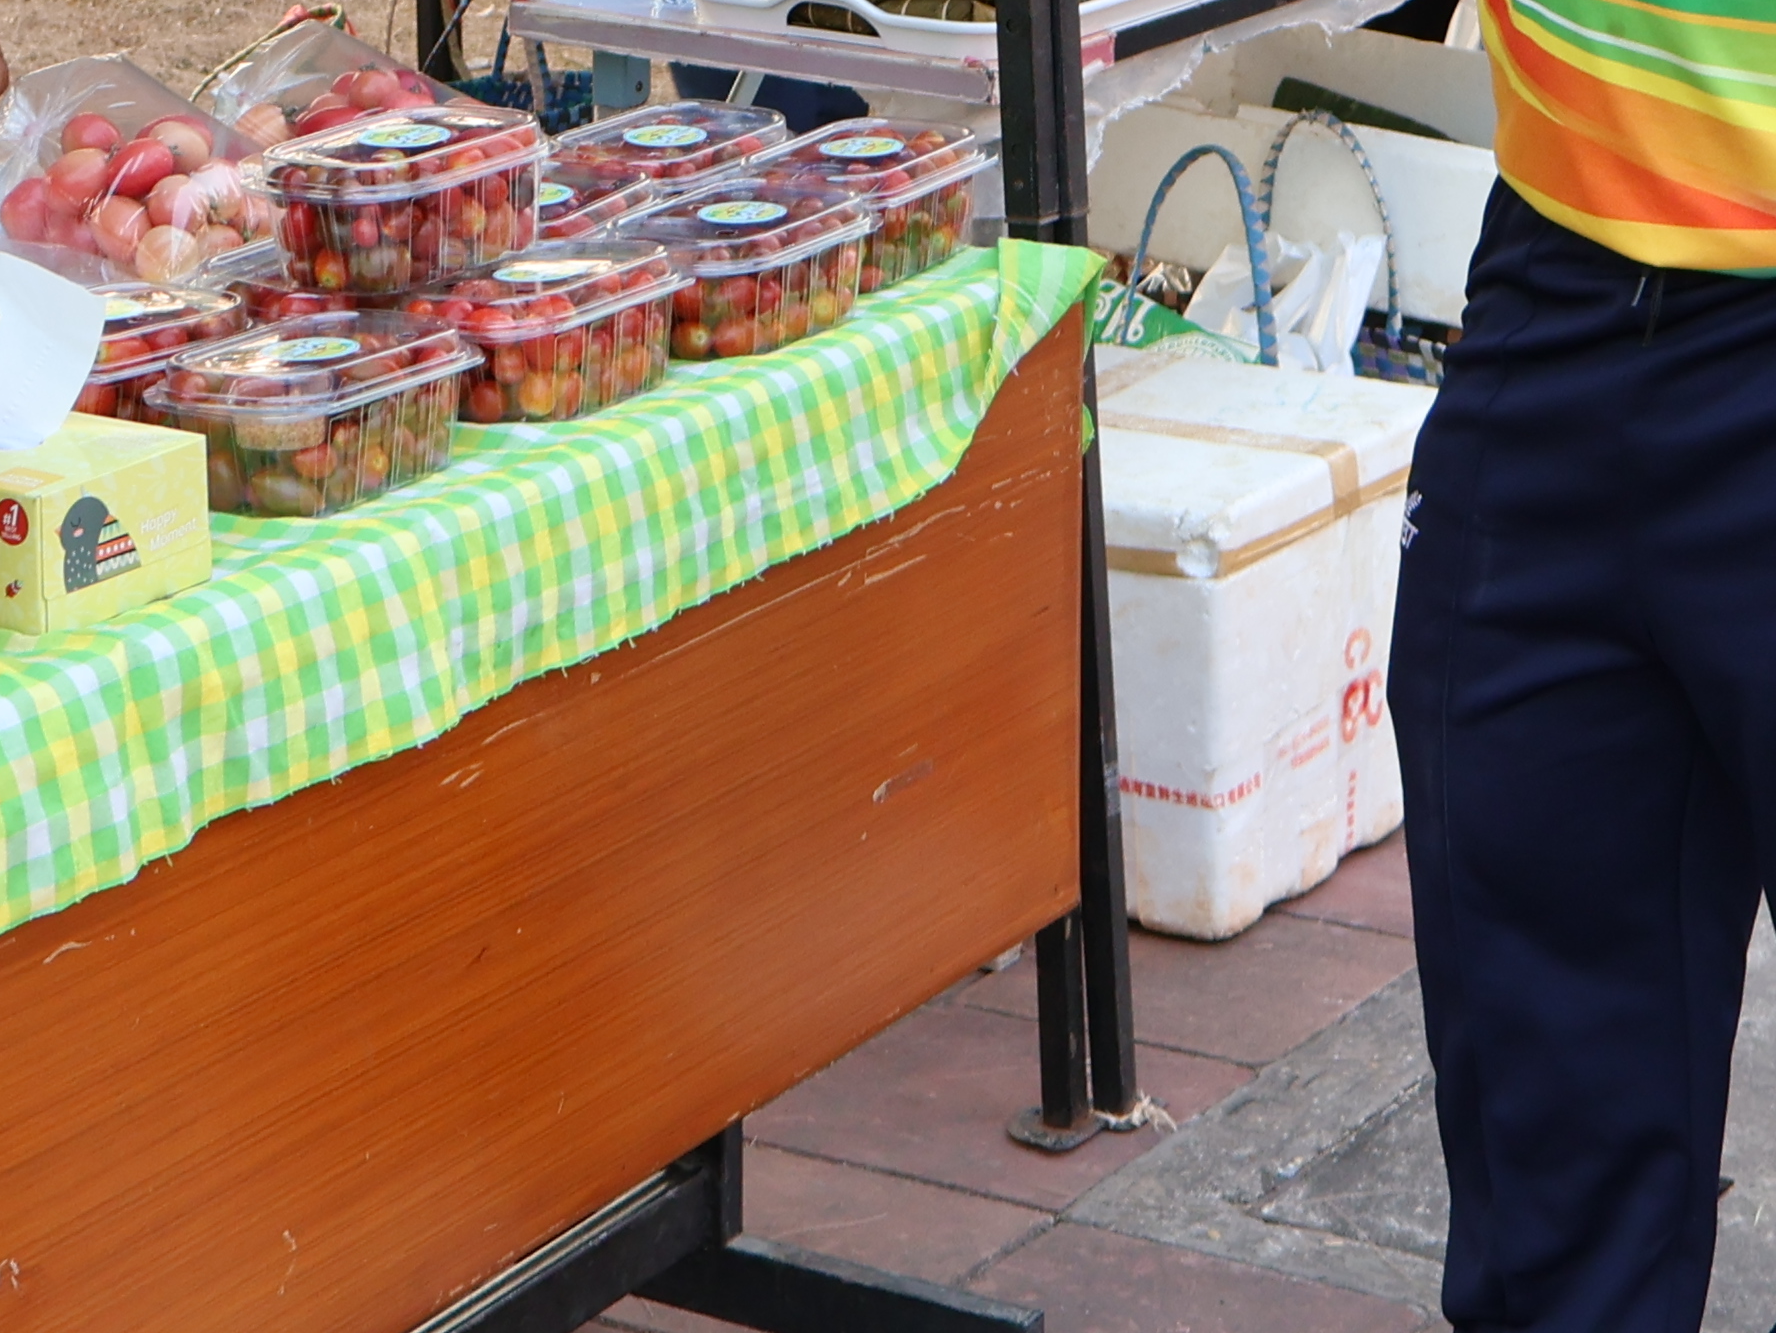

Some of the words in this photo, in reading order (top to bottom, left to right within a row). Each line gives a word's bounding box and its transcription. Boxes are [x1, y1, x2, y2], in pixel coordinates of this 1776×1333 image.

[2, 504, 19, 527] #1
[139, 507, 177, 535] Happy
[149, 517, 199, 552] Moment
